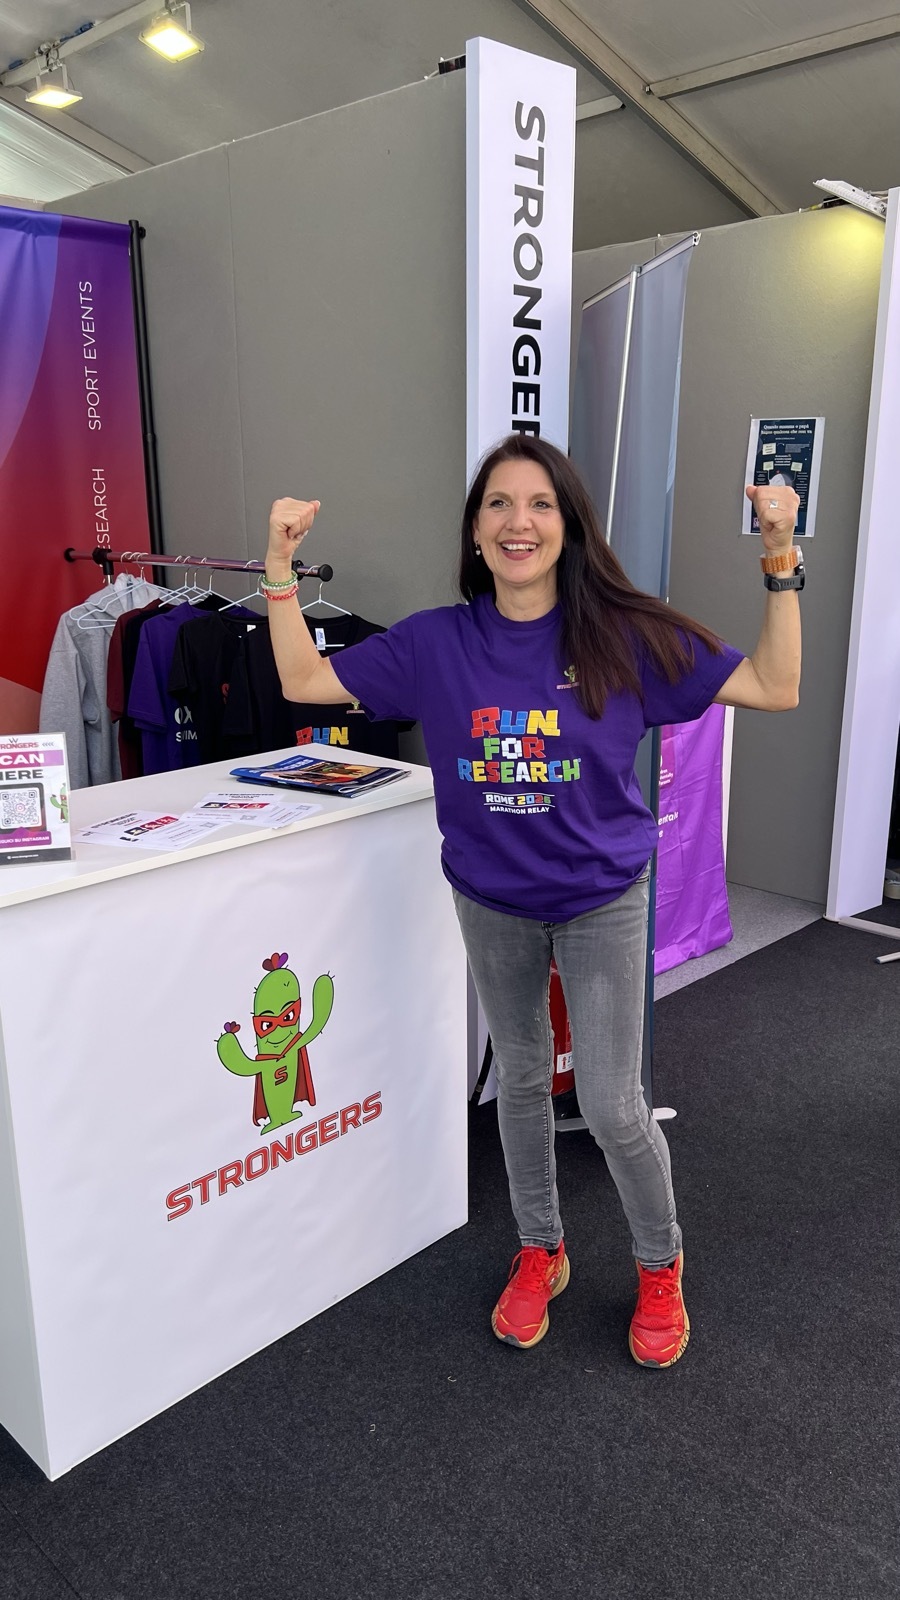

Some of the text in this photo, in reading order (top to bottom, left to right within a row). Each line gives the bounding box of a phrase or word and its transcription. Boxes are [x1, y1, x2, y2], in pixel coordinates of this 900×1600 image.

[78, 281, 102, 431] SPORT EVENTS
[92, 468, 111, 551] SEARCH
[471, 706, 561, 738] RUN
[0, 742, 39, 750] RONGERS
[295, 726, 350, 746] RUN
[483, 736, 546, 760] FOR
[0, 753, 44, 766] CAN
[485, 794, 515, 805] ROME
[490, 806, 550, 815] MARATHON RELAY
[274, 1065, 288, 1086] S
[166, 1091, 383, 1222] STRONGERS
